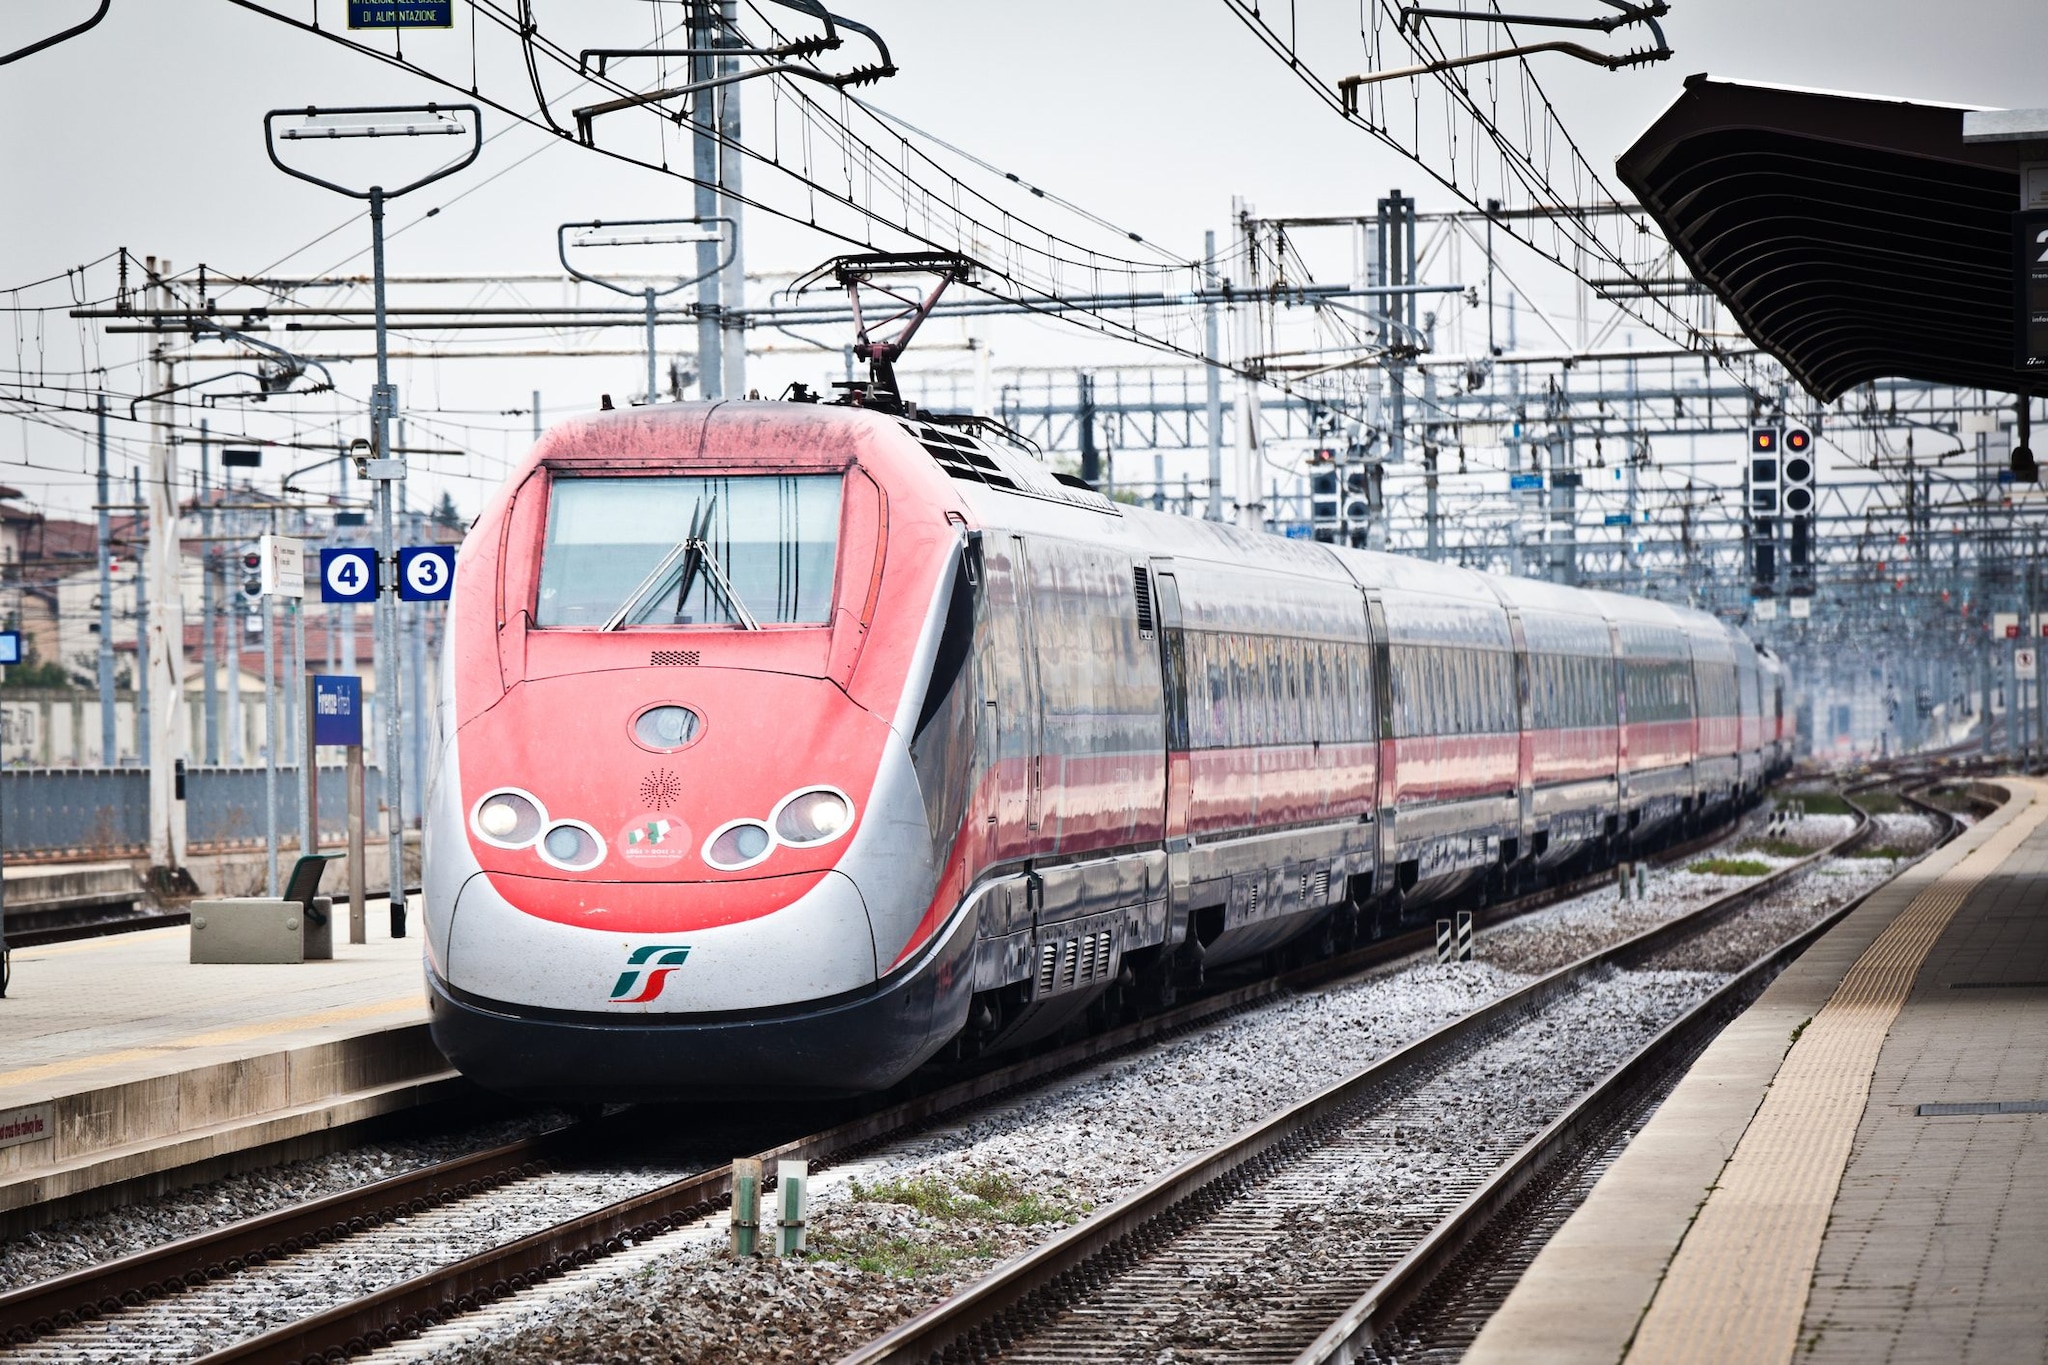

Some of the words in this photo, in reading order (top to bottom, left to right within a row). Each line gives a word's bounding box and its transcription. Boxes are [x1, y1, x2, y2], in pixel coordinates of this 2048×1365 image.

[364, 11, 371, 22] DI
[376, 10, 437, 22] ALIMNTAZIONE
[338, 561, 359, 588] 4
[418, 559, 438, 587] 3
